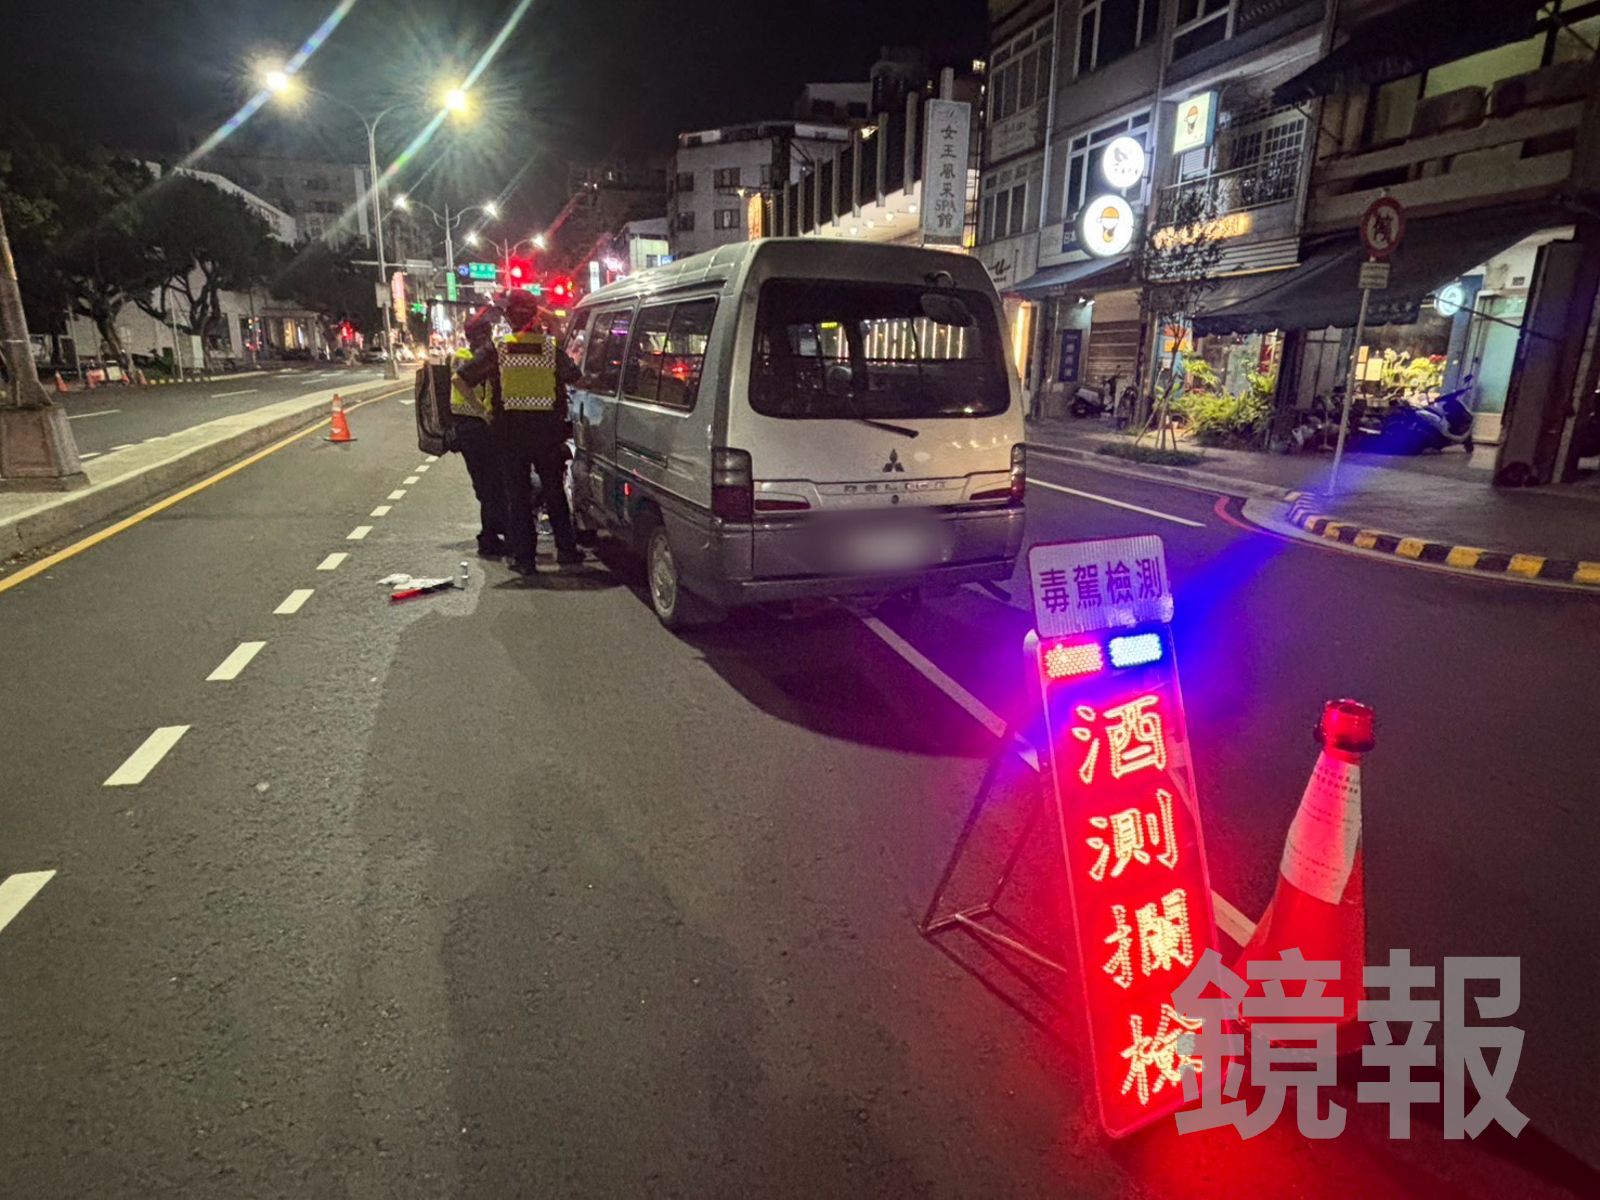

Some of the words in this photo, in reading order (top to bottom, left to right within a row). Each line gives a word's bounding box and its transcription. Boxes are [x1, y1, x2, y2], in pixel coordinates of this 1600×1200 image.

[1039, 556, 1163, 614] 毒駕檢測
[1072, 694, 1205, 1106] 酒測攔檢
